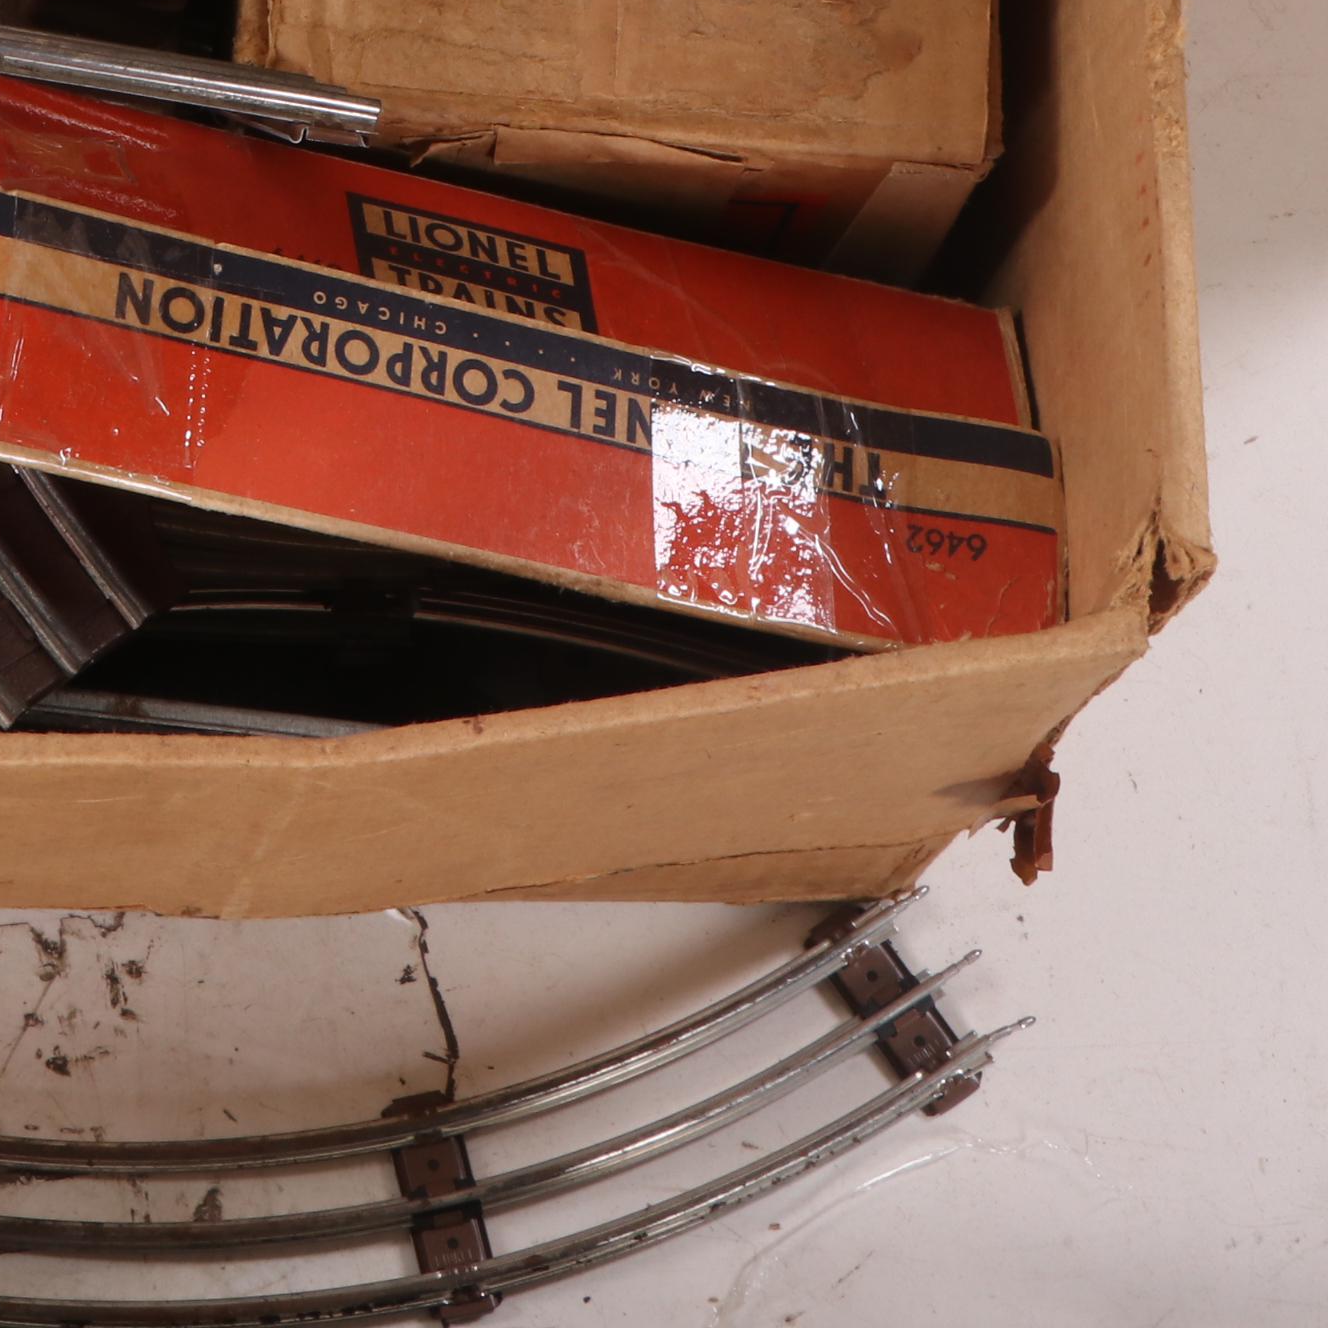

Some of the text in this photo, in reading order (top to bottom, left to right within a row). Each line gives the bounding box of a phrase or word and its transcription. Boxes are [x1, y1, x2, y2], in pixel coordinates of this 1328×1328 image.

[382, 209, 562, 282] LIONEL
[387, 245, 562, 299] ELECTRIC
[312, 290, 447, 335] CHICAGO
[114, 272, 536, 414] CORPORATION
[613, 367, 679, 395] YORK
[906, 523, 988, 561] 6462
